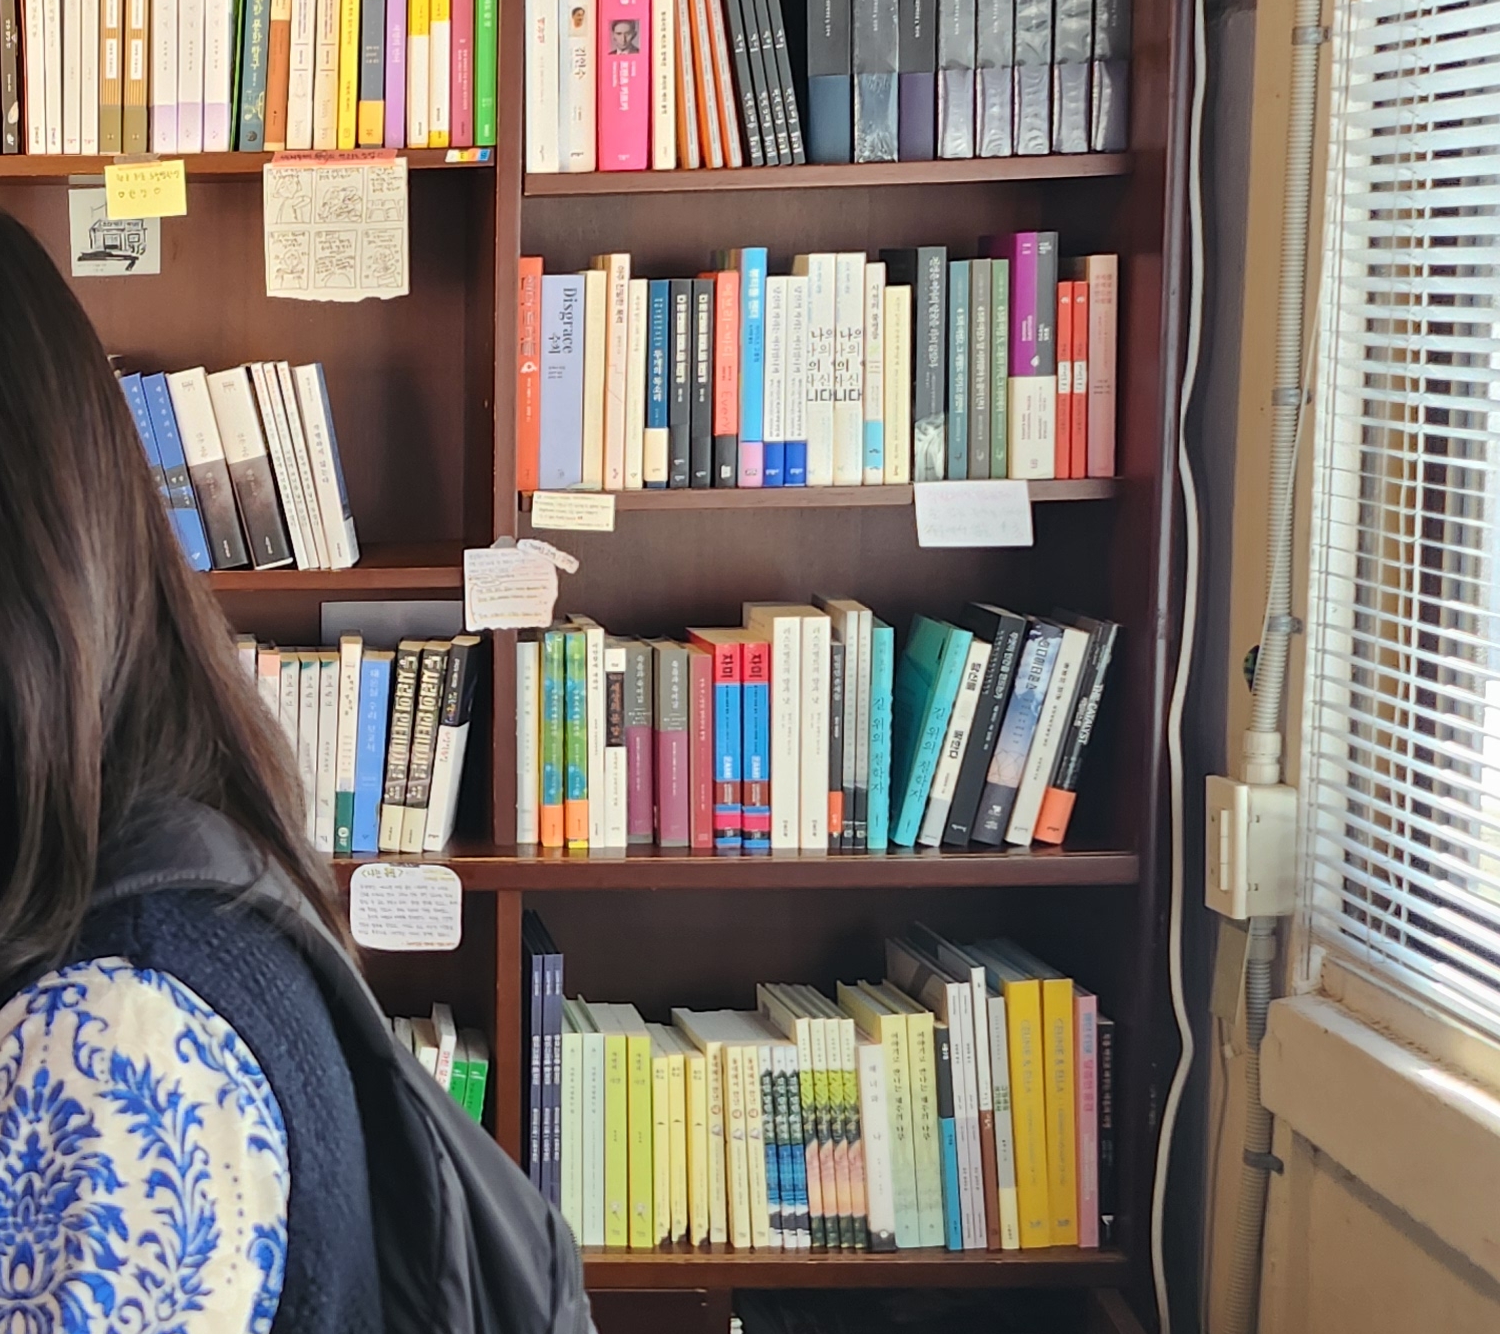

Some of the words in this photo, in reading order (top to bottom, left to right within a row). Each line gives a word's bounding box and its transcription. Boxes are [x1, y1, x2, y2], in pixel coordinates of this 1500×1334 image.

[559, 287, 578, 355] Disgrace
[548, 332, 561, 355] 수치
[720, 653, 733, 678] 자미
[749, 653, 762, 678] 자미
[872, 697, 885, 710] 길
[1094, 682, 1105, 702] THE
[933, 706, 947, 718] 길
[1078, 701, 1100, 745] CATALYST
[871, 718, 885, 746] 위의
[922, 726, 941, 754] 위의
[870, 752, 885, 795] 철학자
[909, 760, 932, 803] 철학자
